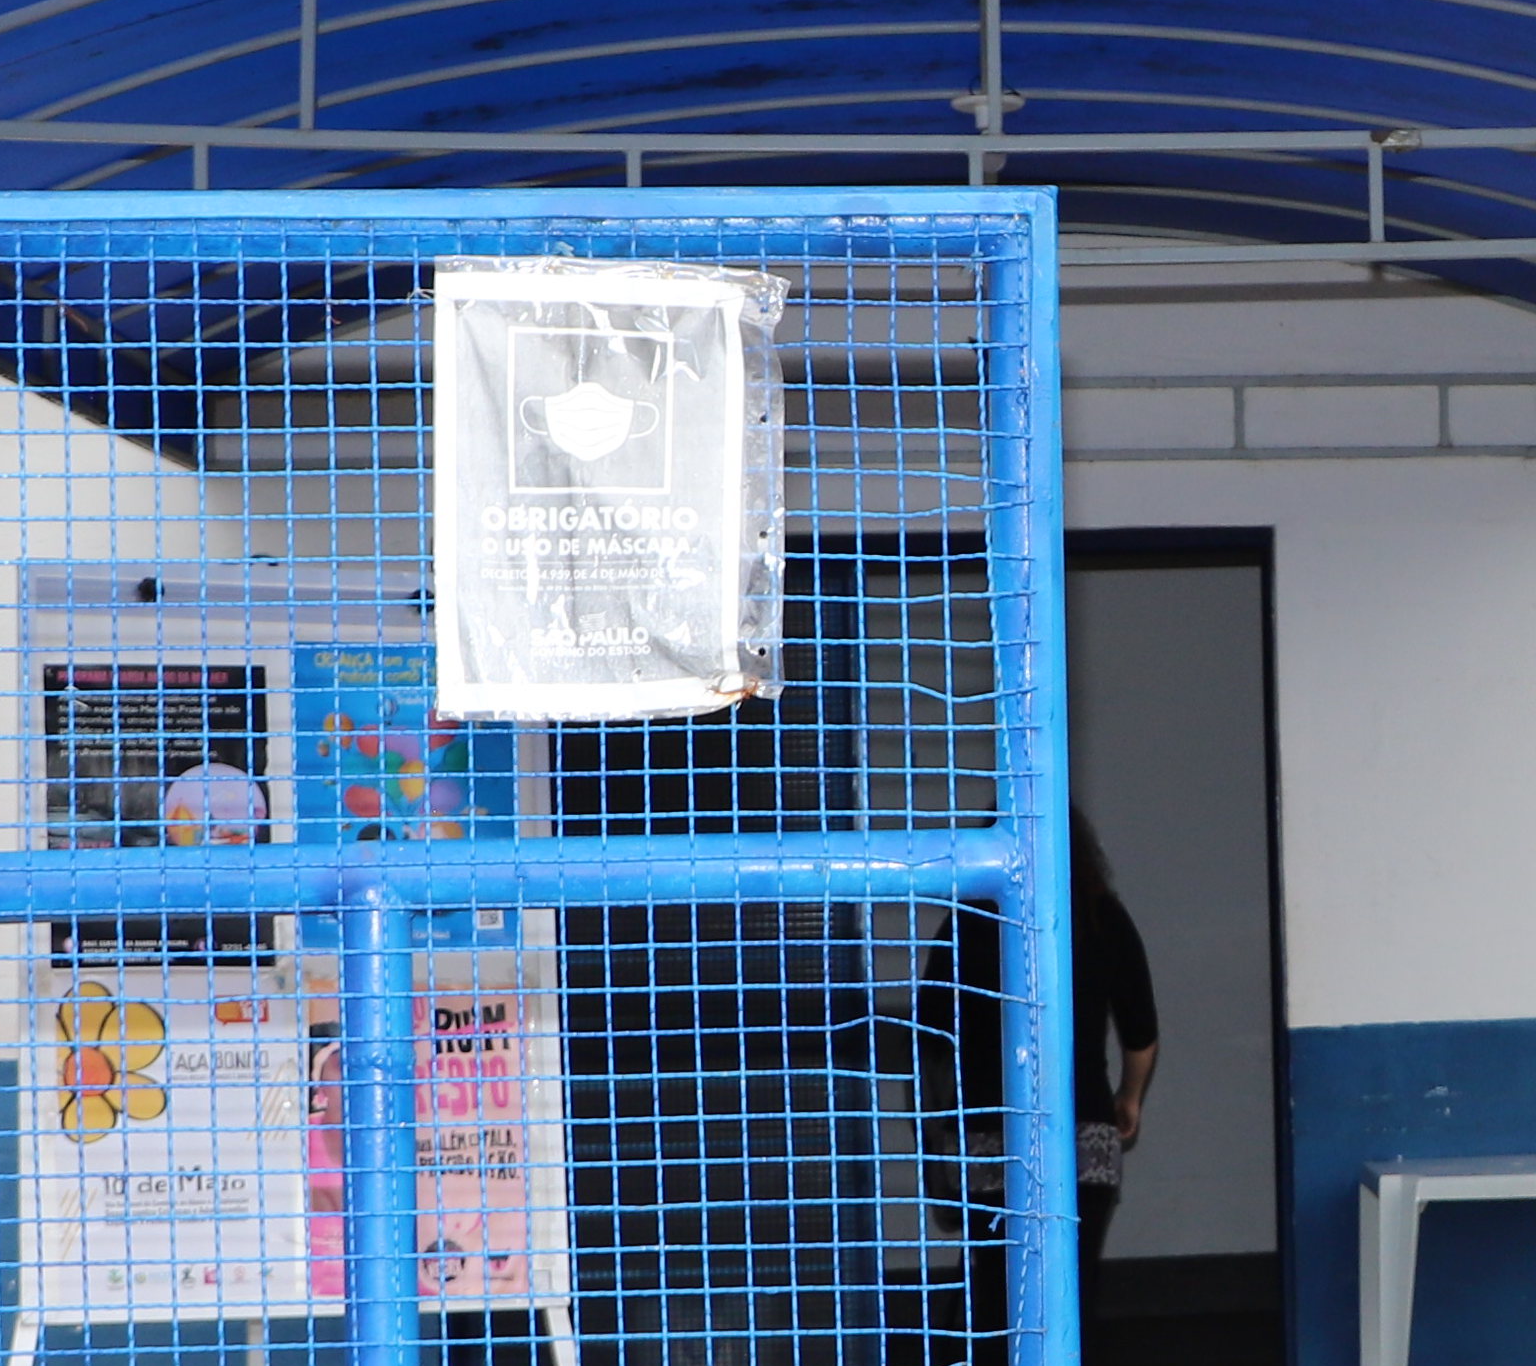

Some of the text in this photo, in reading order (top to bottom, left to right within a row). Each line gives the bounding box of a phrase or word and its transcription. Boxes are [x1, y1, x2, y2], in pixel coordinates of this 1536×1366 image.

[481, 499, 699, 531] OBRIGATÓRIO
[481, 537, 498, 554] O
[559, 539, 580, 555] DE
[573, 568, 588, 580] DE
[579, 627, 649, 645] PAULO
[587, 646, 607, 656] DO
[168, 1050, 270, 1071] AÇA BONIO
[137, 1173, 167, 1194] de
